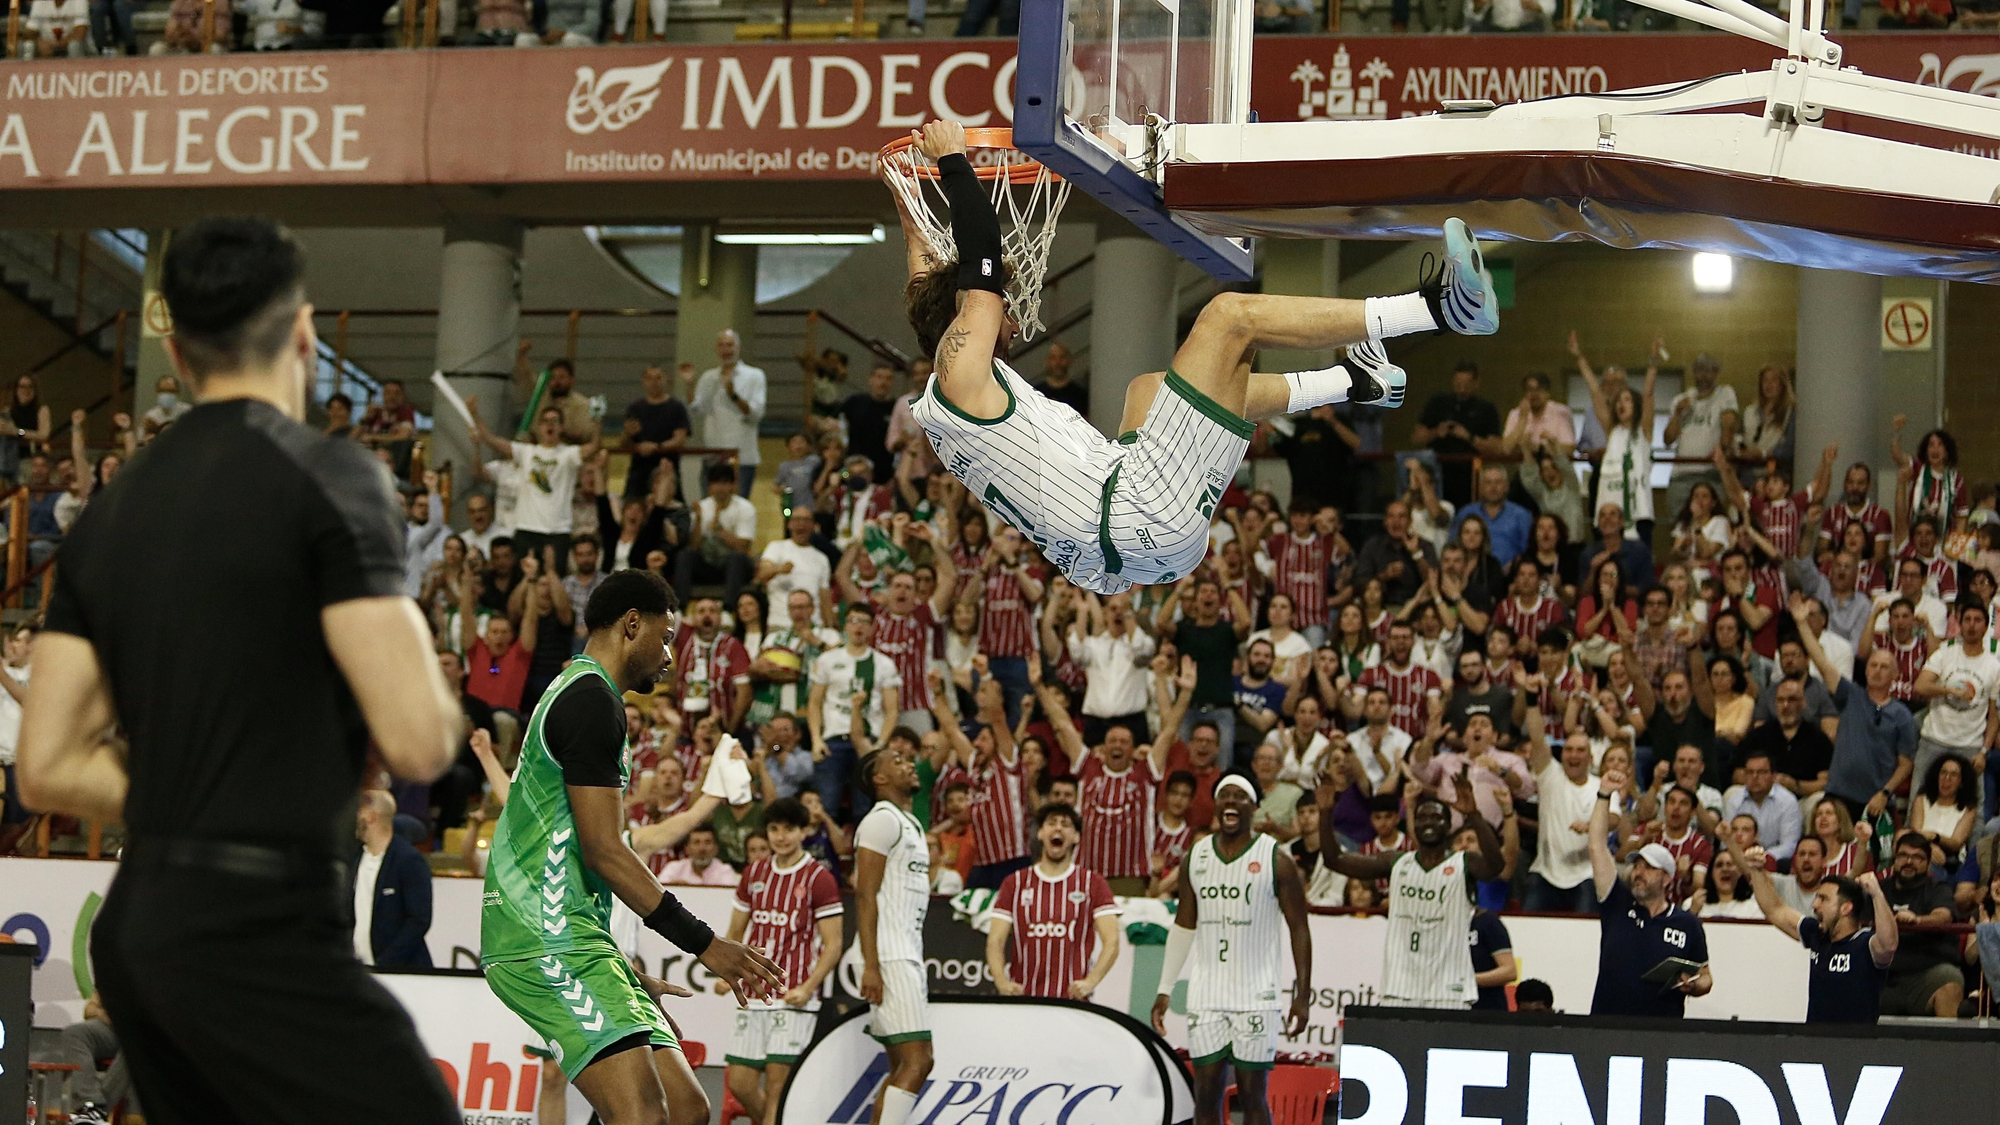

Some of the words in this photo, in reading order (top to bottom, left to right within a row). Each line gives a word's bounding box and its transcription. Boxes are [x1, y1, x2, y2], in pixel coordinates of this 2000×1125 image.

[7, 70, 168, 100] MUNICIPAL
[178, 65, 329, 96] DEPORTES
[1401, 66, 1609, 104] AYUNTAMIENTO
[66, 105, 371, 177] ALEGRE
[565, 148, 667, 172] Instituto
[674, 145, 787, 176] Municipal
[797, 146, 831, 172] de
[1136, 528, 1154, 551] PRO
[1219, 939, 1228, 962] 2
[1410, 931, 1420, 952] 8
[958, 1066, 1029, 1082] GRUPO
